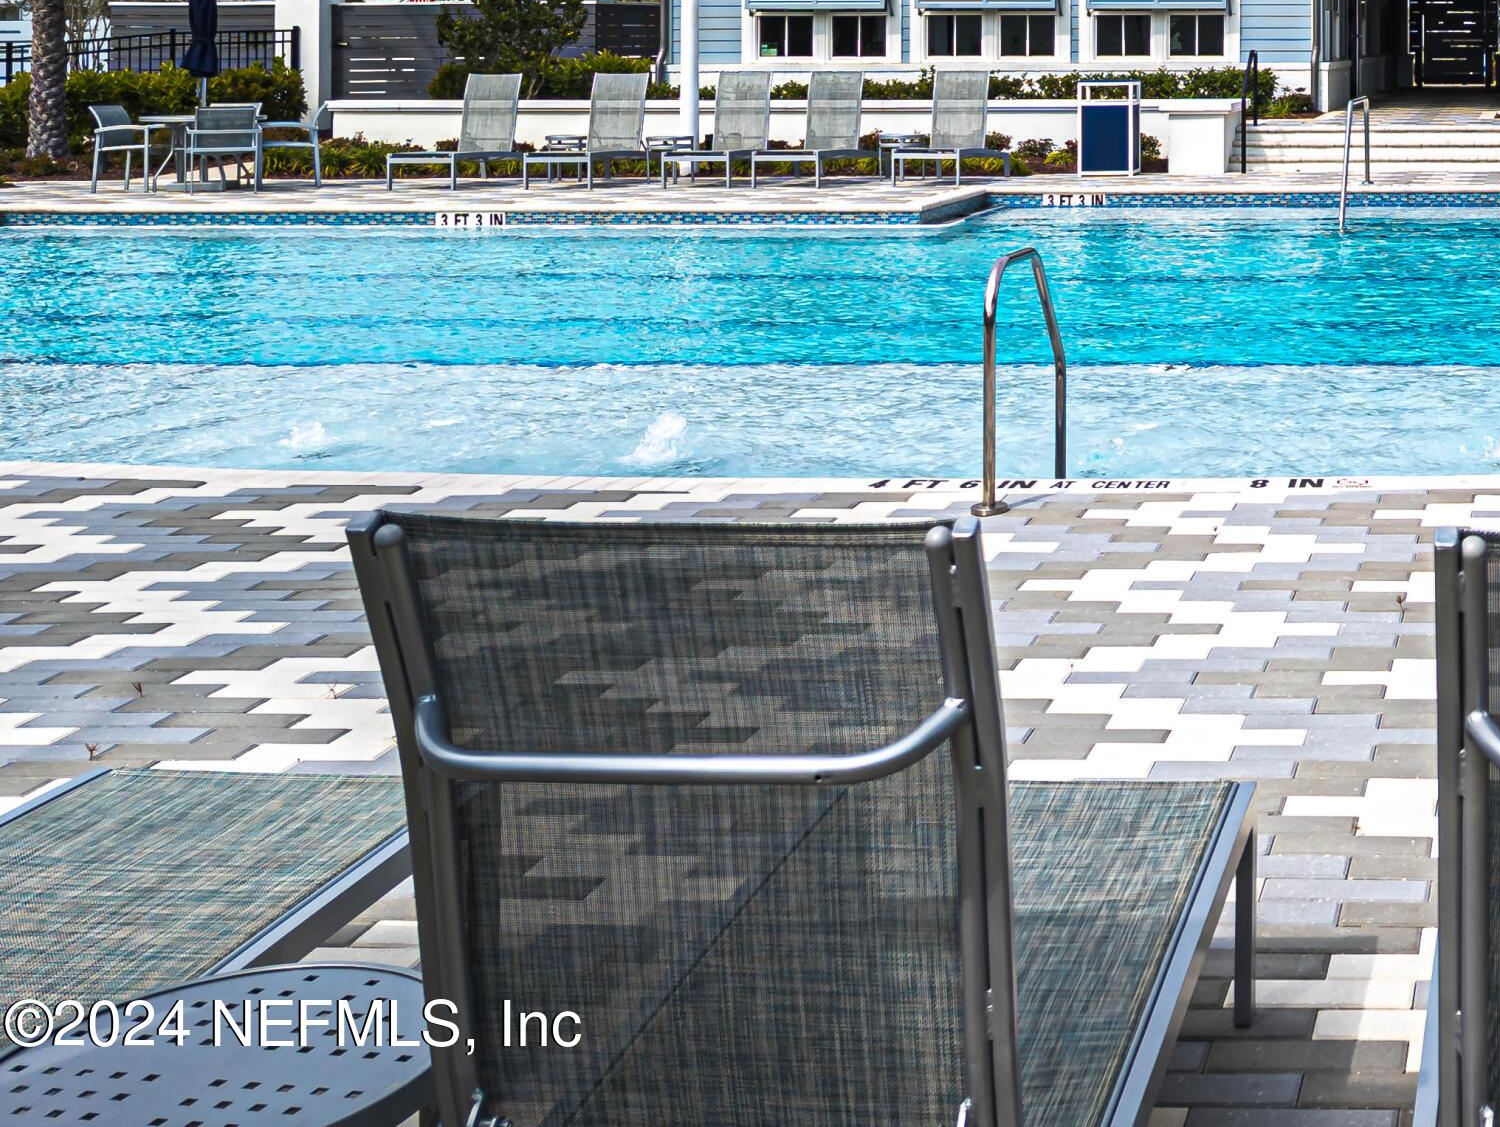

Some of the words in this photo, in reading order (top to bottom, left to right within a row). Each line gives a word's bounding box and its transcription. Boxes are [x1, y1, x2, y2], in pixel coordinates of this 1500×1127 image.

[1060, 194, 1073, 205] FT
[1091, 194, 1104, 205] IN
[454, 213, 469, 225] FT
[490, 213, 504, 225] IN
[868, 479, 891, 489] 4
[902, 479, 949, 489] FT
[959, 480, 983, 489] 6
[997, 480, 1038, 489] IN
[1049, 480, 1077, 489] AT
[1092, 480, 1171, 489] CENTER
[1250, 479, 1270, 488] 8
[1287, 478, 1324, 488] IN
